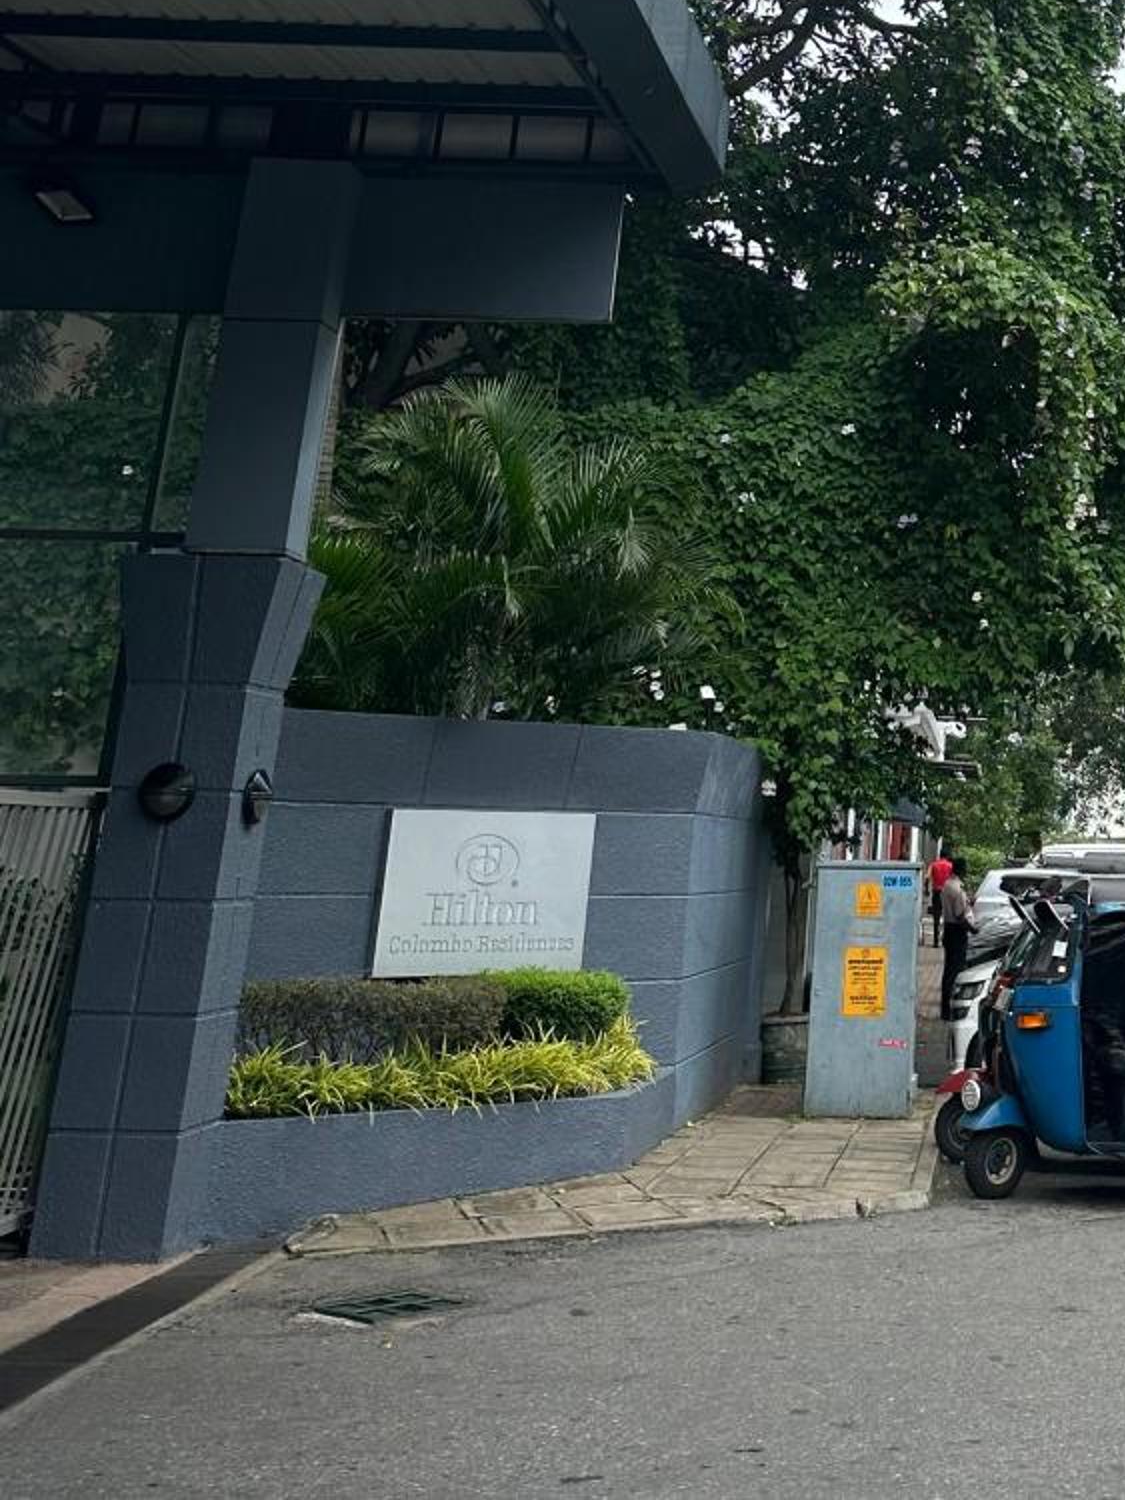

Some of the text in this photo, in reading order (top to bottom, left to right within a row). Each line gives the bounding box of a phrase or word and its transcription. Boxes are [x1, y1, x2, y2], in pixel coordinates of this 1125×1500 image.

[421, 888, 538, 927] Hilton
[389, 932, 576, 955] Colombo Residences
